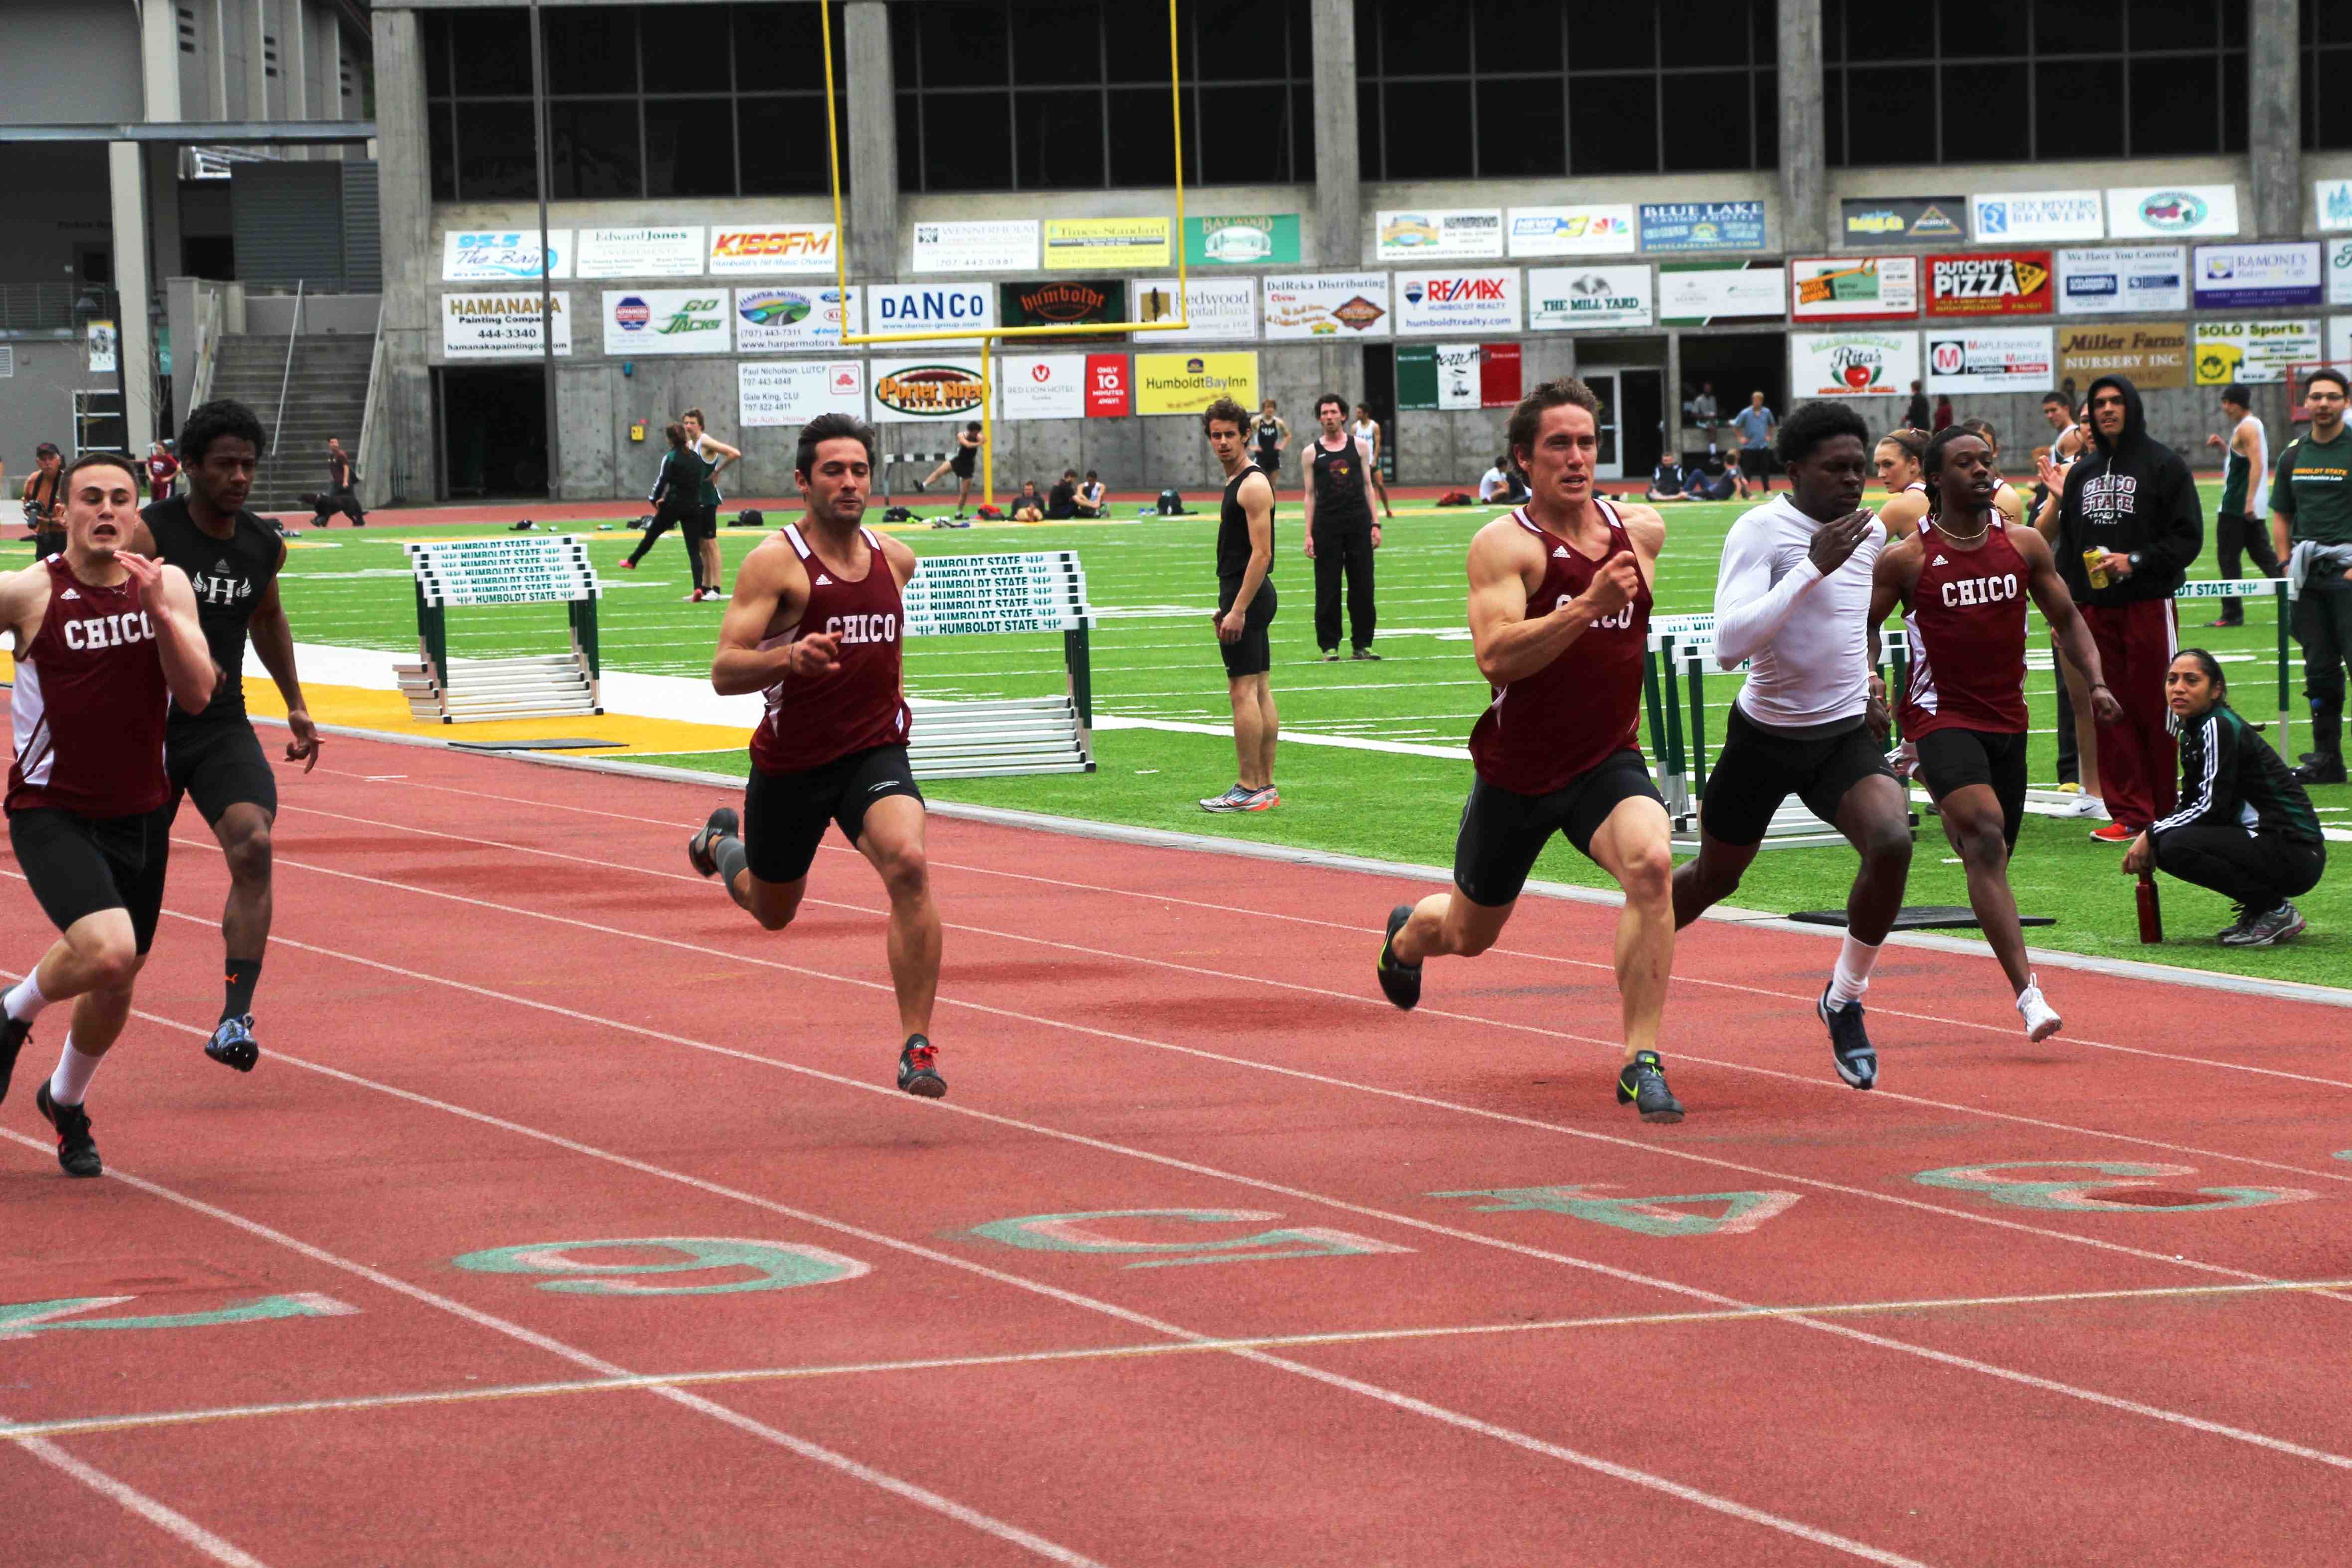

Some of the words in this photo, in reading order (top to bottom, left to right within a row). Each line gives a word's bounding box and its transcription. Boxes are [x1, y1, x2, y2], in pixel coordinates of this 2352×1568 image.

[1644, 205, 1699, 217] BLUE
[1707, 203, 1763, 215] LAKE
[2012, 202, 2035, 211] SIX
[457, 234, 521, 248] 95.5
[596, 232, 644, 241] Edward
[648, 231, 687, 240] Jones
[457, 247, 489, 264] The
[495, 247, 539, 273] Bay
[2086, 252, 2111, 261] Have
[2115, 251, 2133, 260] You
[2136, 250, 2178, 259] Covered
[1935, 259, 2013, 274] DUTCHY'S
[1318, 279, 1385, 289] Distributing
[1428, 278, 1505, 302] RE/MAX
[1934, 274, 2020, 298] PIZZA
[450, 297, 561, 315] HAMANAKA
[682, 300, 719, 311] GO
[881, 292, 983, 319] DANCO
[1543, 300, 1567, 311] THE
[1571, 299, 1602, 310] MILL
[1604, 298, 1638, 309] YARD
[1175, 307, 1216, 318] Cpital
[652, 313, 724, 334] JACKS
[1406, 317, 1511, 327] humboldtrealty.com
[478, 329, 536, 338] 444-3340
[2198, 324, 2243, 337] SOLO
[2250, 324, 2304, 337] Sports
[447, 343, 567, 351] hamanakapaintingcoom
[2062, 334, 2125, 354] Miller
[2131, 332, 2185, 348] Farms
[1831, 346, 1882, 369] Rita's
[1938, 349, 1958, 367] M
[2065, 355, 2142, 368] NURSERY
[2149, 354, 2182, 367] INC.
[1097, 376, 1119, 389] 10
[879, 377, 939, 402] Porter
[942, 381, 983, 399] Stree
[2082, 493, 2134, 515] STATE
[923, 557, 983, 568] HUMBOLDT
[988, 556, 1020, 565] STATE
[926, 568, 986, 577] HUMBOLDT
[991, 567, 1023, 575] STATE
[472, 585, 521, 593] HUMBOLDT
[930, 579, 990, 588] HUMBOLDT
[995, 577, 1027, 586] STATE
[2197, 583, 2232, 595] STATE
[476, 593, 525, 603] HUMBOLDT
[530, 591, 556, 600] STATE
[931, 589, 991, 599] HUMBOLDT
[996, 588, 1028, 596] STATE
[1942, 573, 2018, 608] CHICO
[930, 600, 990, 610] HUMBOLDT
[996, 598, 1028, 607] STATE
[935, 610, 995, 620] HUMBOLDT
[1000, 609, 1032, 618] STATE
[64, 610, 156, 650] CHICO
[826, 614, 895, 643] CHICO
[940, 621, 1001, 635] HUMBOLDT
[1005, 619, 1038, 631] STATE
